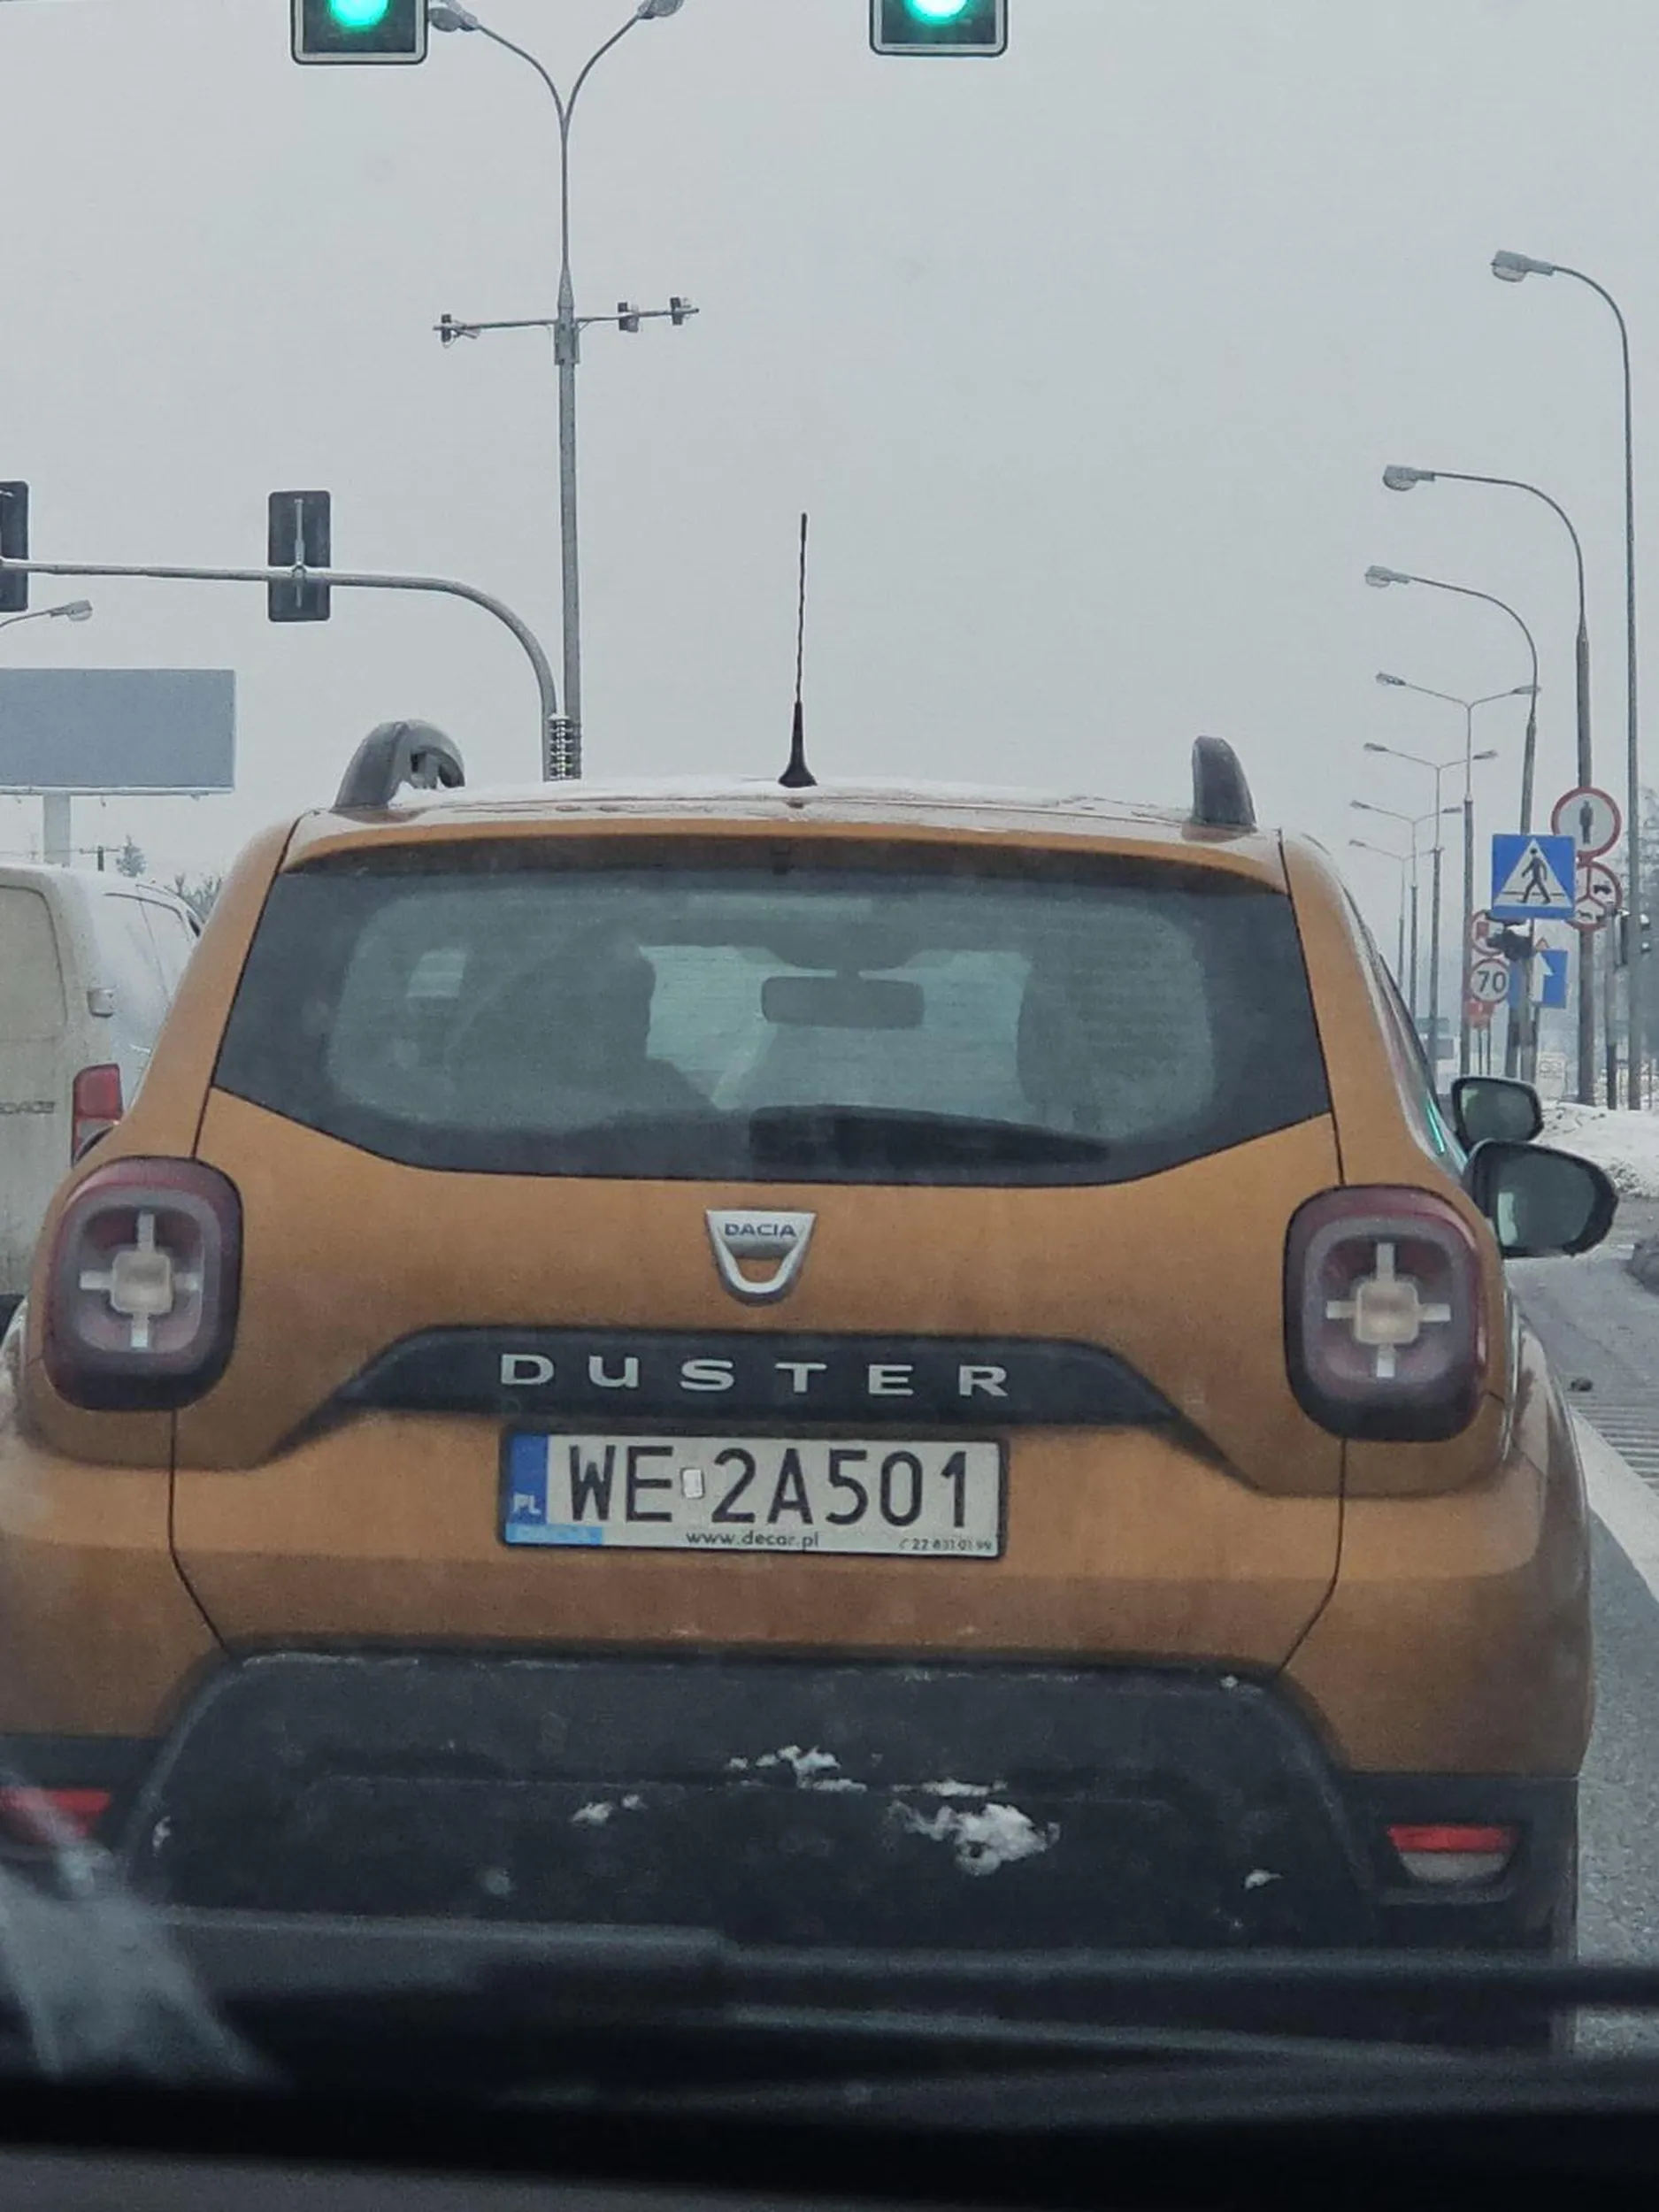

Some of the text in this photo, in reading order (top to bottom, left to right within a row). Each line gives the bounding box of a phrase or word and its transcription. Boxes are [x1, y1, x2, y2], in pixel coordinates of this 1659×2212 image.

[1478, 971, 1507, 993] 70
[725, 1223, 796, 1239] DACIA
[501, 1354, 1008, 1396] DUSTER
[569, 1445, 967, 1529] WE 2A501
[511, 1493, 542, 1516] PL
